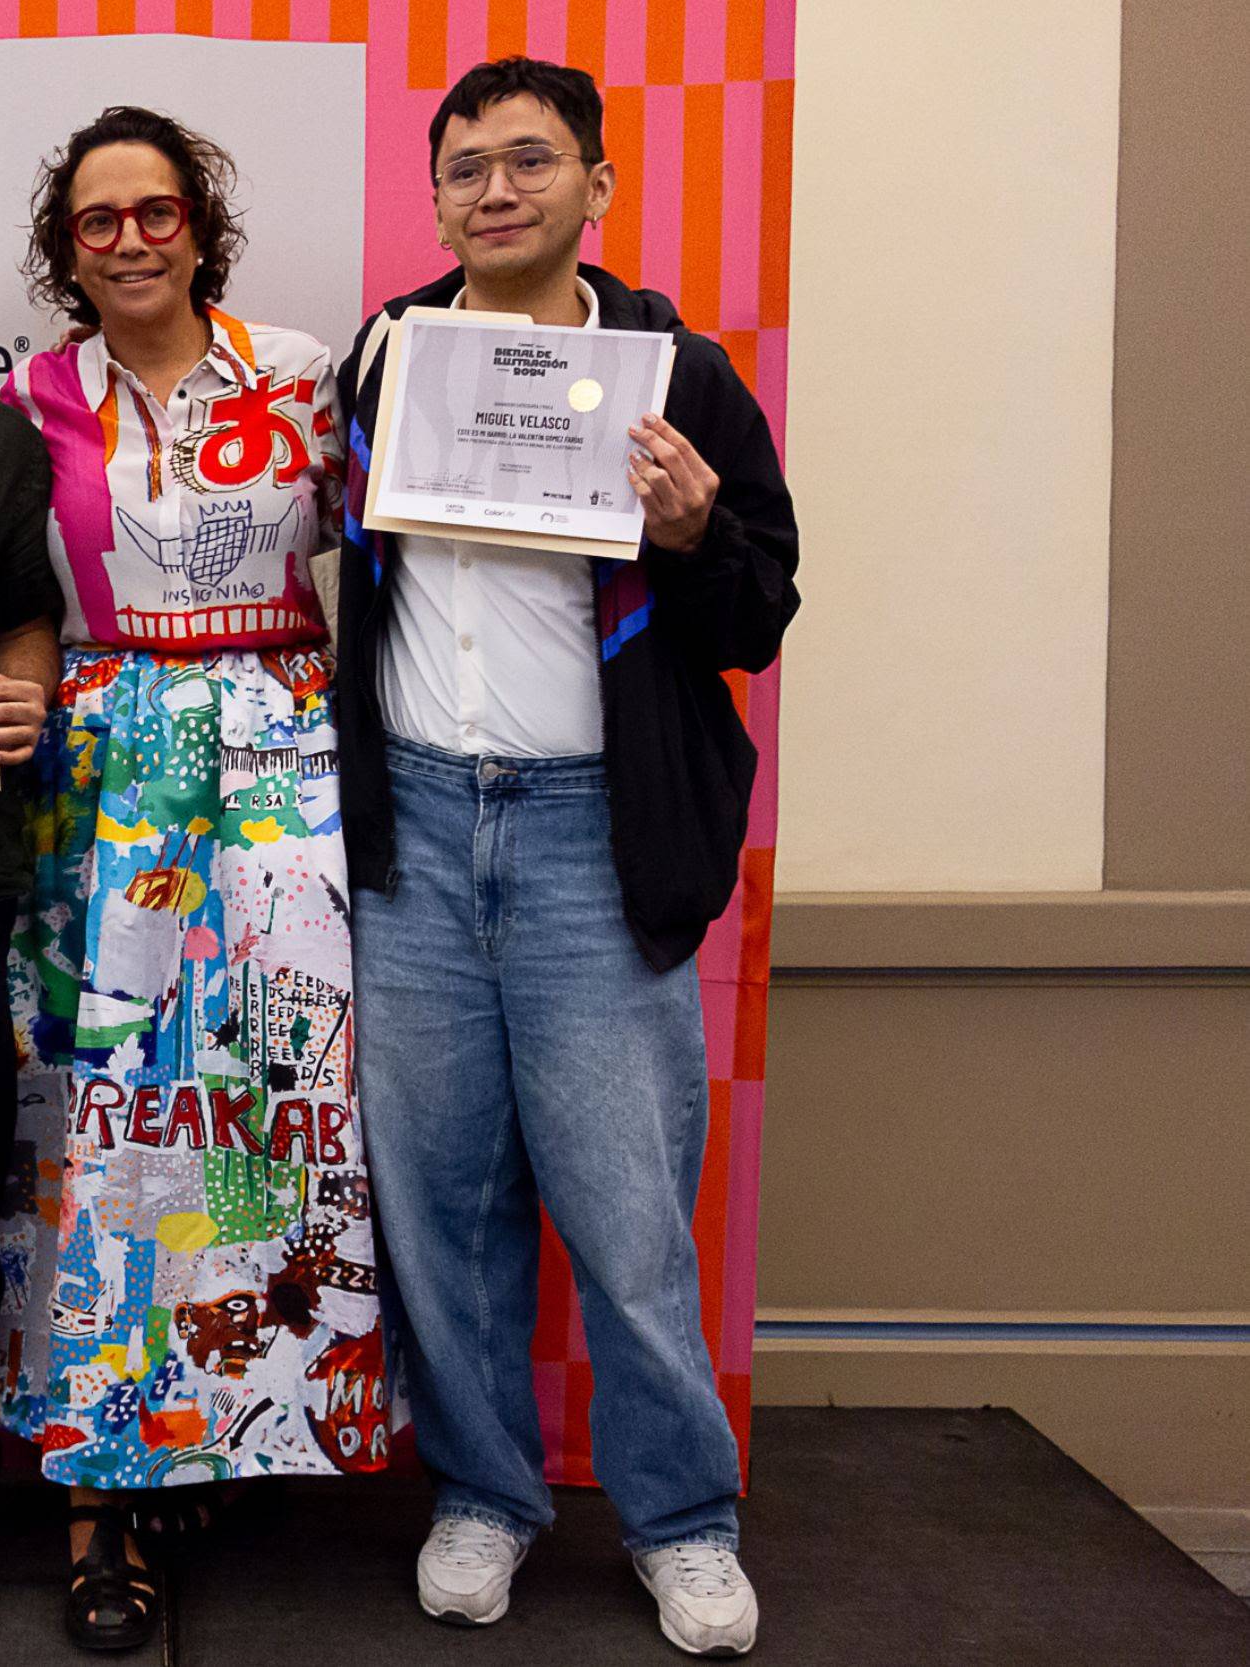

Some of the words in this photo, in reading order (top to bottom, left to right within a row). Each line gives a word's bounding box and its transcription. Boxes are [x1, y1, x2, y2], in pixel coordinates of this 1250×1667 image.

[536, 350, 552, 359] DE
[513, 367, 546, 377] 2024
[475, 412, 516, 427] MIGUEL
[520, 414, 570, 430] VELASCO
